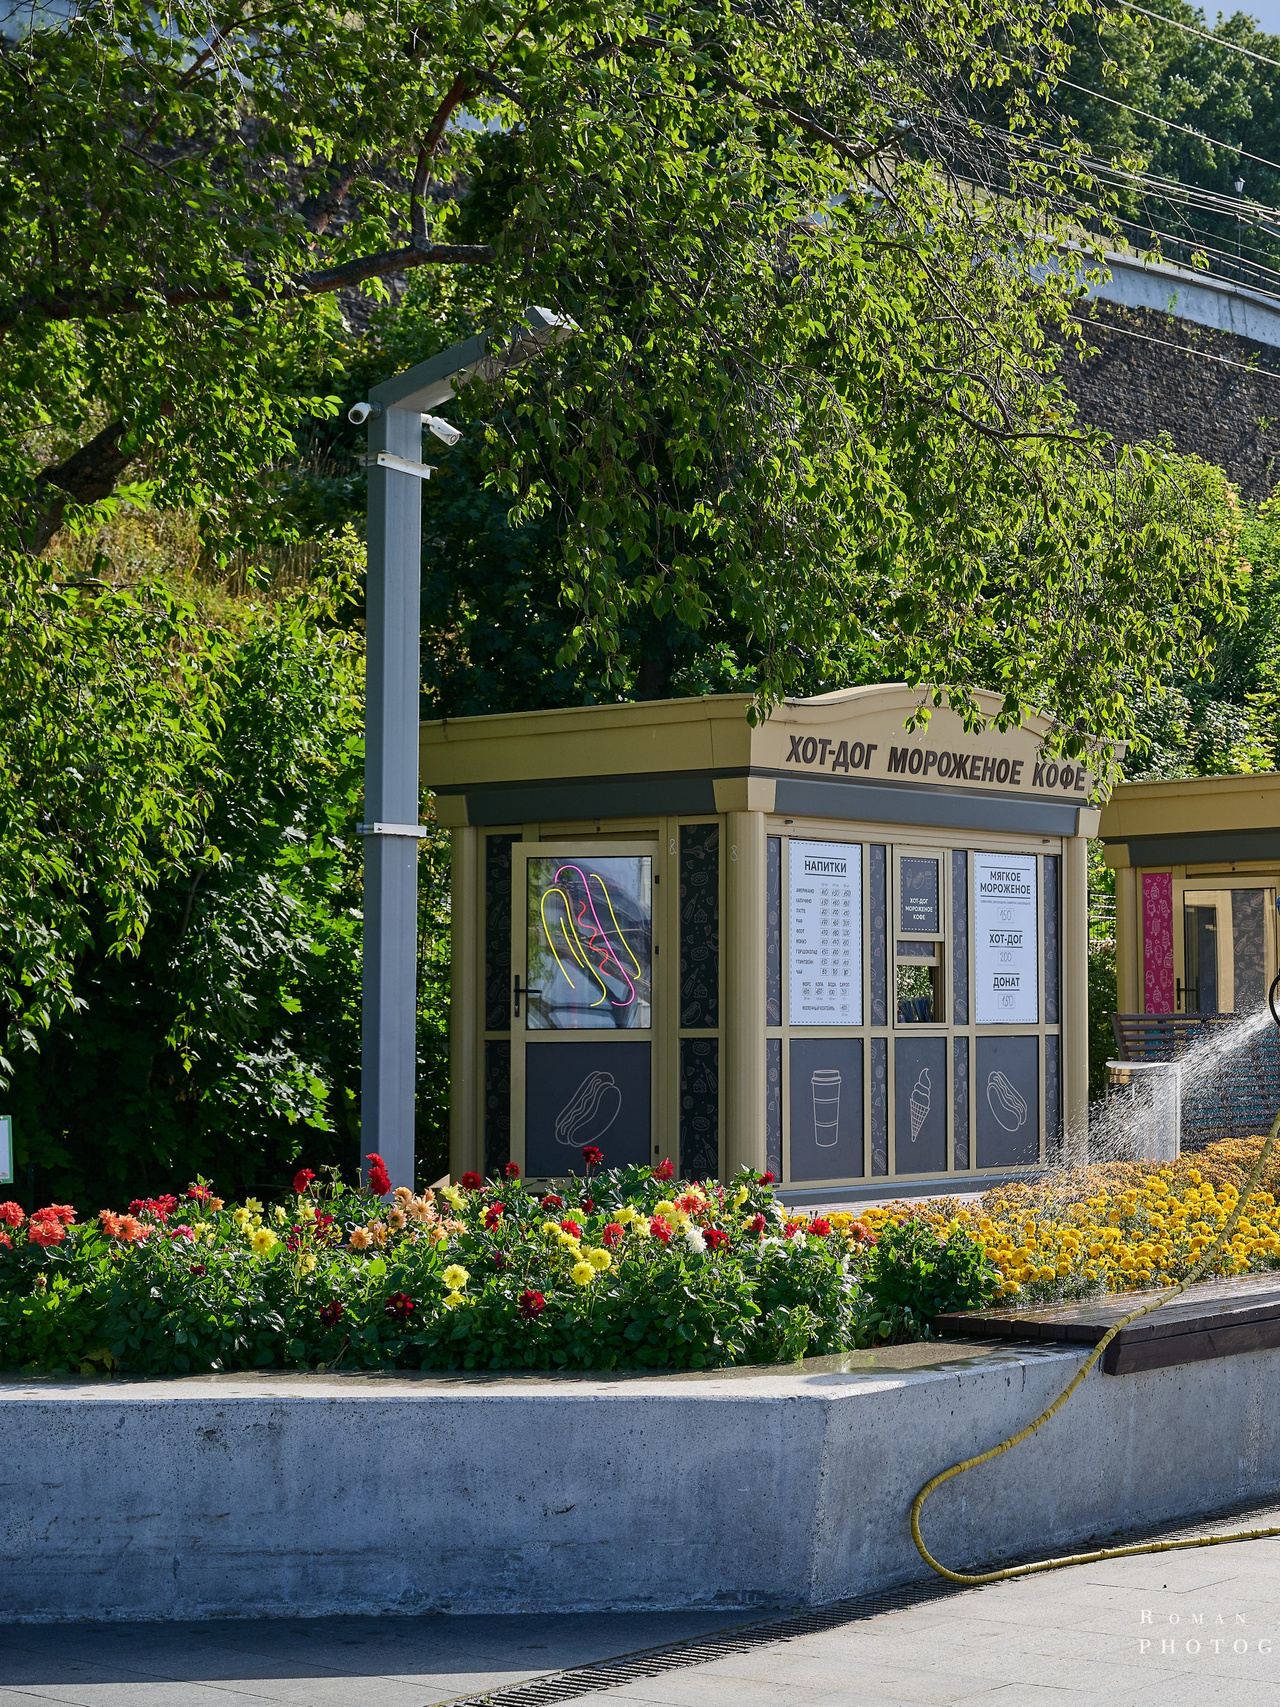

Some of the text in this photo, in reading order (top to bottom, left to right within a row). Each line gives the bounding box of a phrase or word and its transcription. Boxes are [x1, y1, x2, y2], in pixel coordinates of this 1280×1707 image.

[786, 735, 1088, 791] ХОТ-ДОГ МОРОЖЕНОЕ КОФЕ
[804, 860, 846, 873] НАПИТКИ
[990, 871, 1021, 882] МЯГКОЕ
[980, 883, 1031, 894] МОРОЖЕНОЕ
[910, 897, 929, 905] ХОТ-ДОГ
[989, 934, 1023, 946] ХОТ-ДОГ
[993, 977, 1020, 988] ДОНАТ
